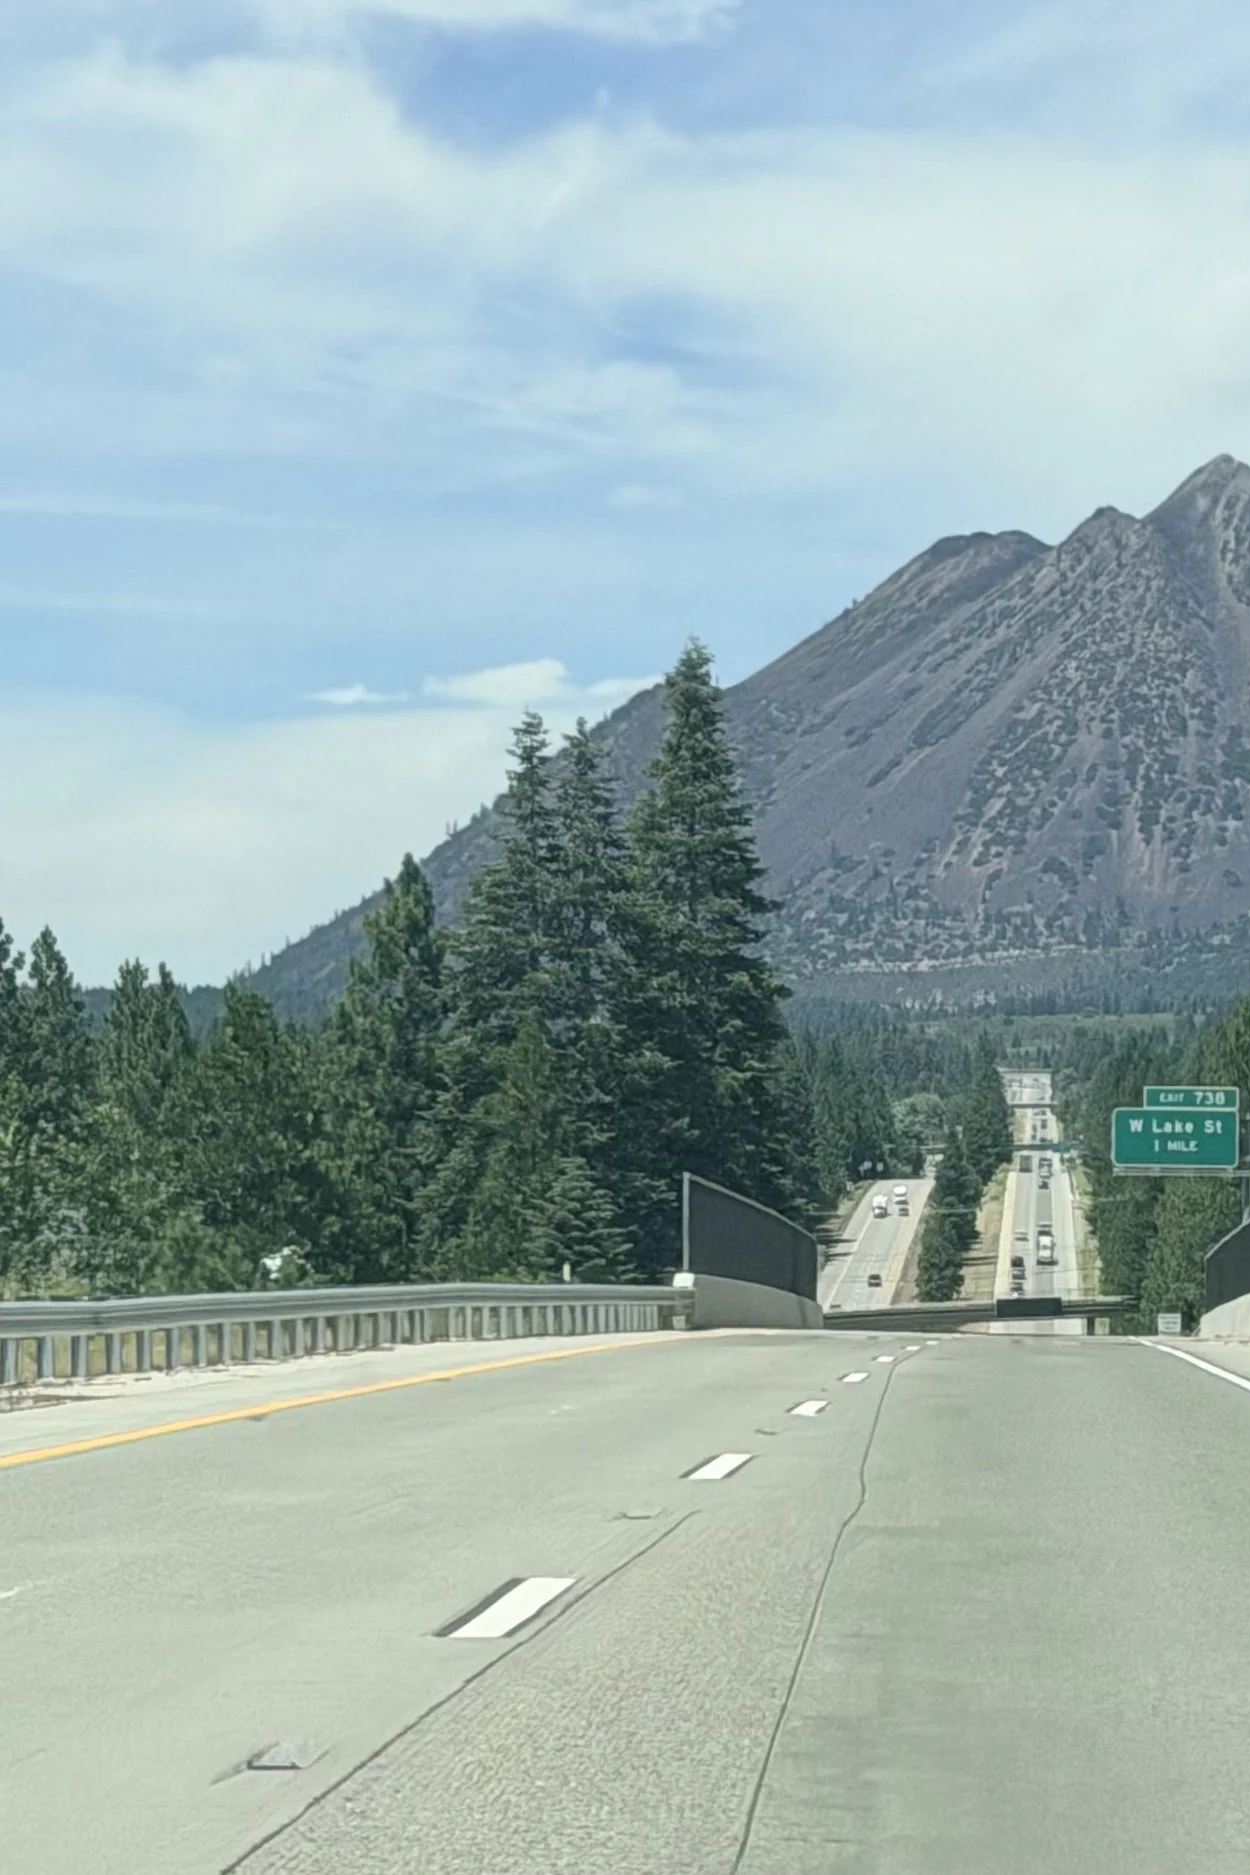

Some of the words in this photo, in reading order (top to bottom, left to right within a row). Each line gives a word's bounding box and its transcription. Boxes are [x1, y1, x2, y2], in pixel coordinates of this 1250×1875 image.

[1159, 1092, 1185, 1104] EXIT
[1129, 1119, 1144, 1133] W
[1152, 1119, 1194, 1134] Lake
[1204, 1120, 1223, 1134] St
[1154, 1140, 1159, 1152] 1
[1167, 1140, 1199, 1152] MILE
